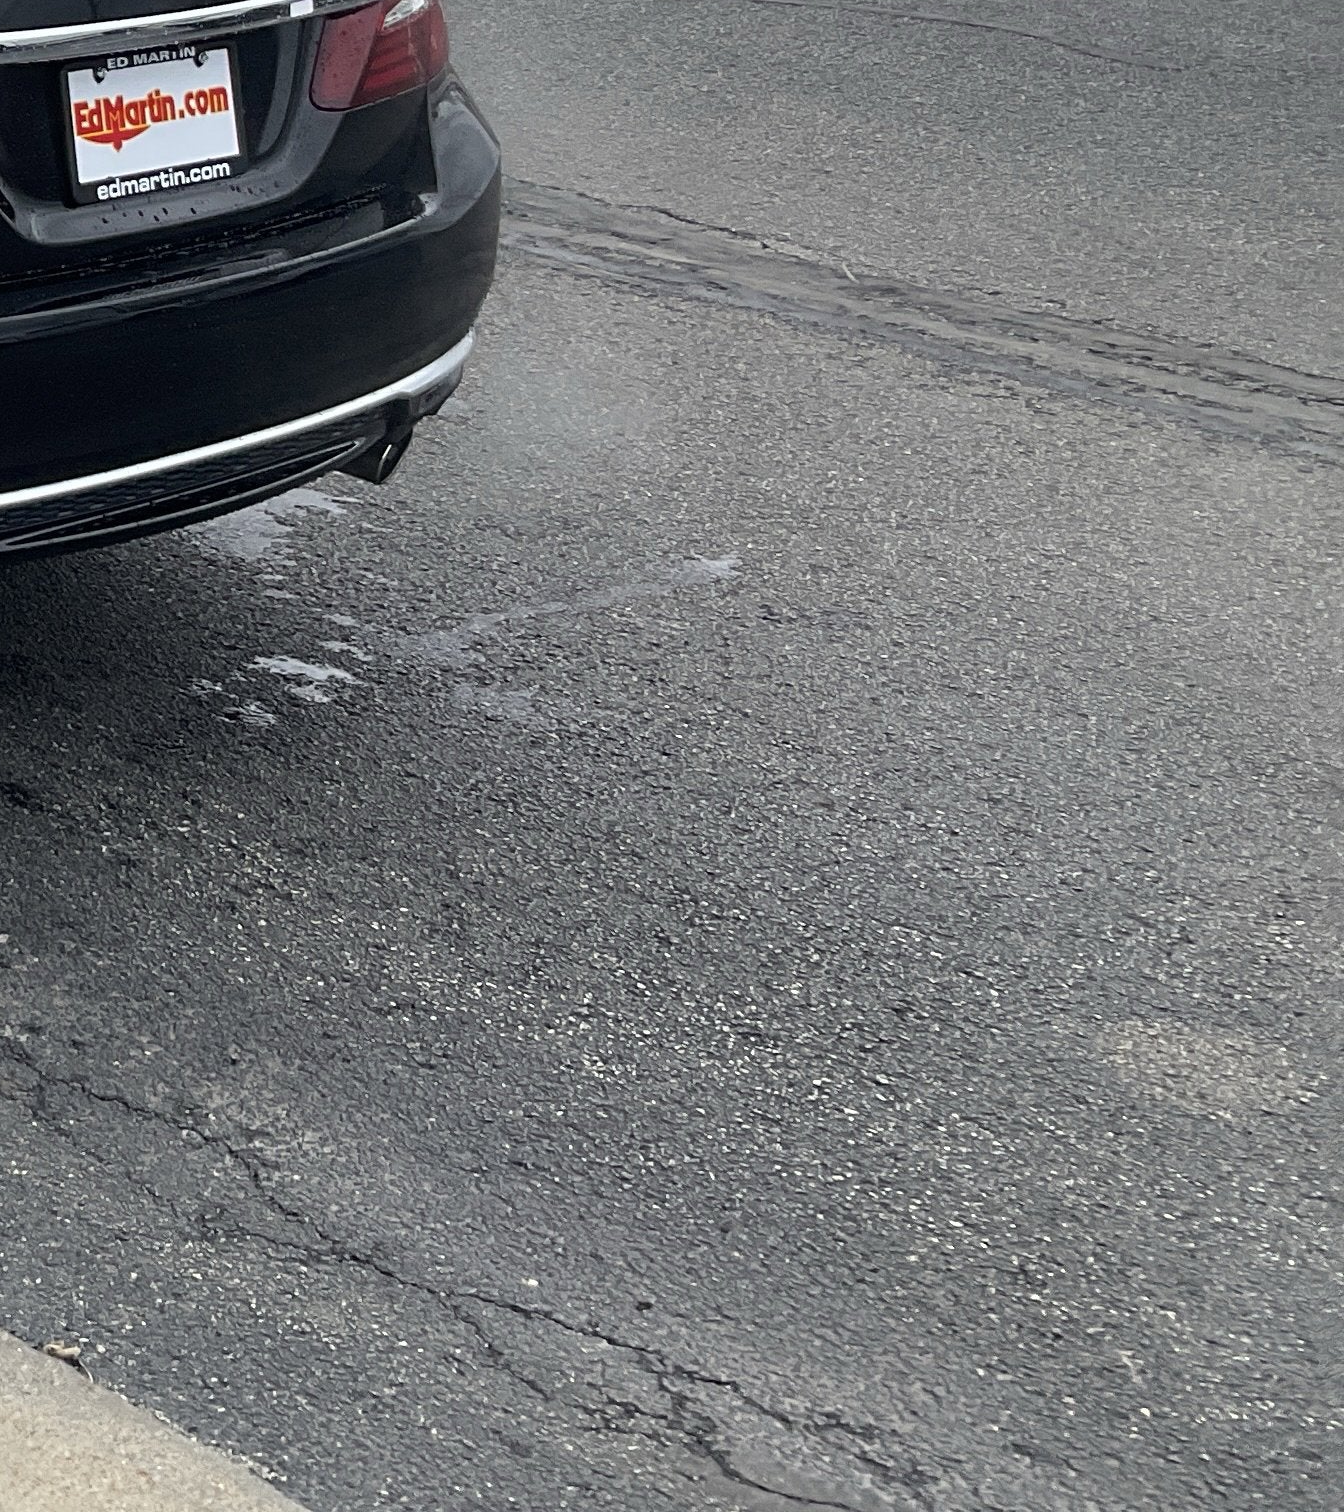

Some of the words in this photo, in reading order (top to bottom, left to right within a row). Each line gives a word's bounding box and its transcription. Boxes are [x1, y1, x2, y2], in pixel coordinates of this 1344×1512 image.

[107, 56, 129, 70] ED
[133, 46, 196, 66] MARTIN
[73, 86, 230, 137] EdMartin.com
[96, 161, 231, 201] edmartin.com
